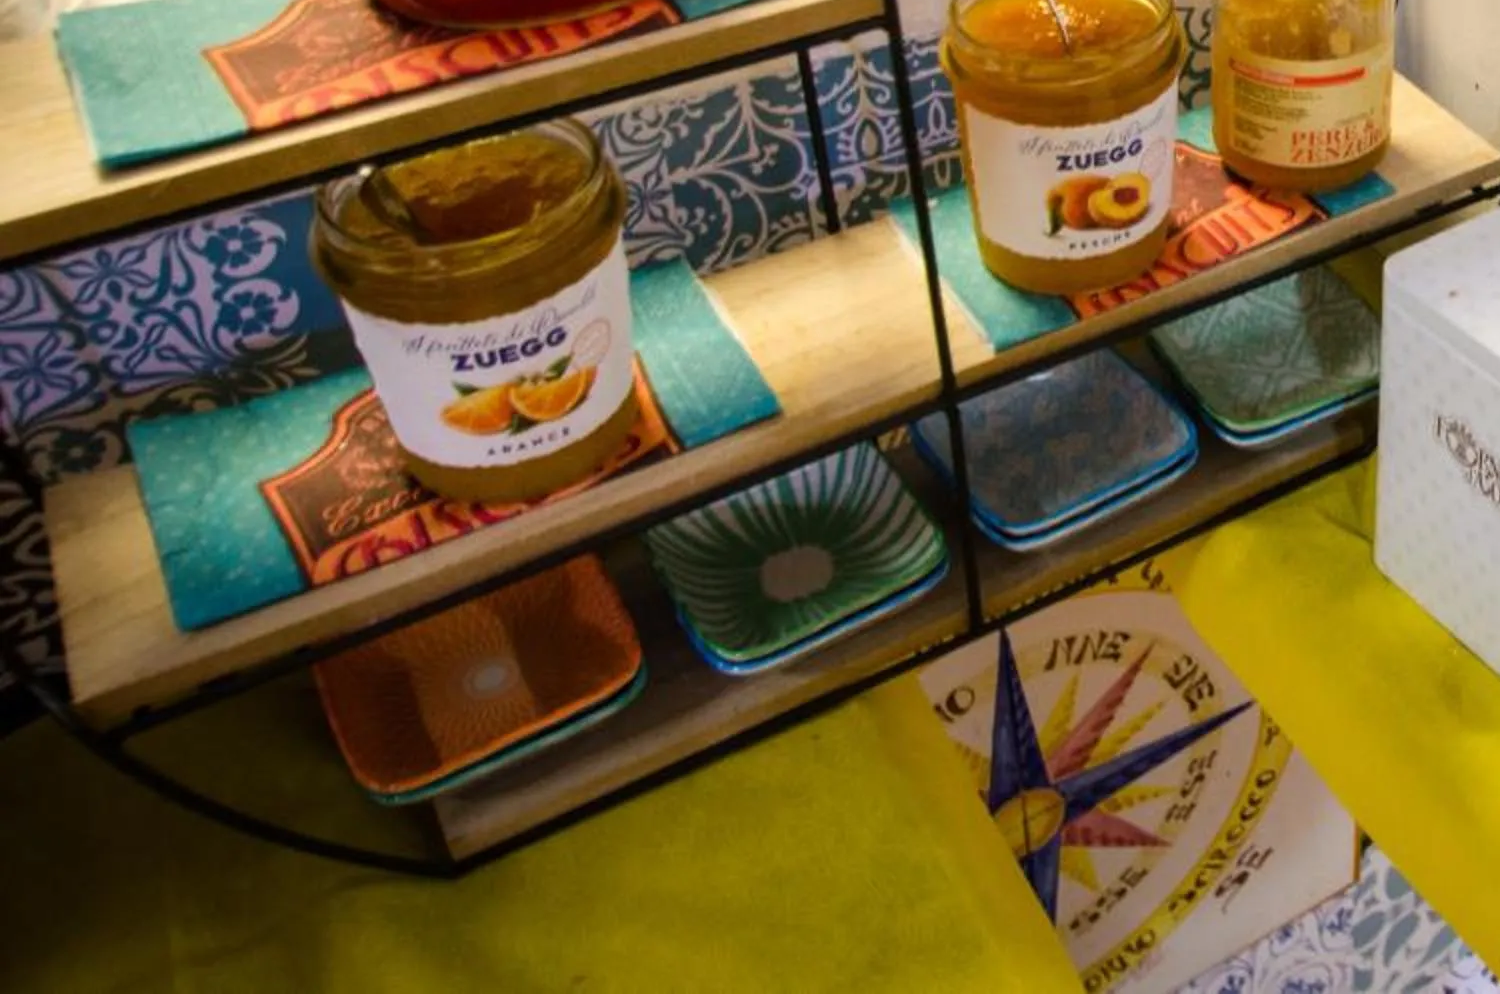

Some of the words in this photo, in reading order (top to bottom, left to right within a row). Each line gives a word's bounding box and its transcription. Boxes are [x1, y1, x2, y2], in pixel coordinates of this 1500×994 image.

[1055, 137, 1144, 172] ZUEGG
[451, 324, 568, 373] ZUEGG
[486, 426, 571, 456] ARANCE
[1044, 628, 1132, 672] NNE
